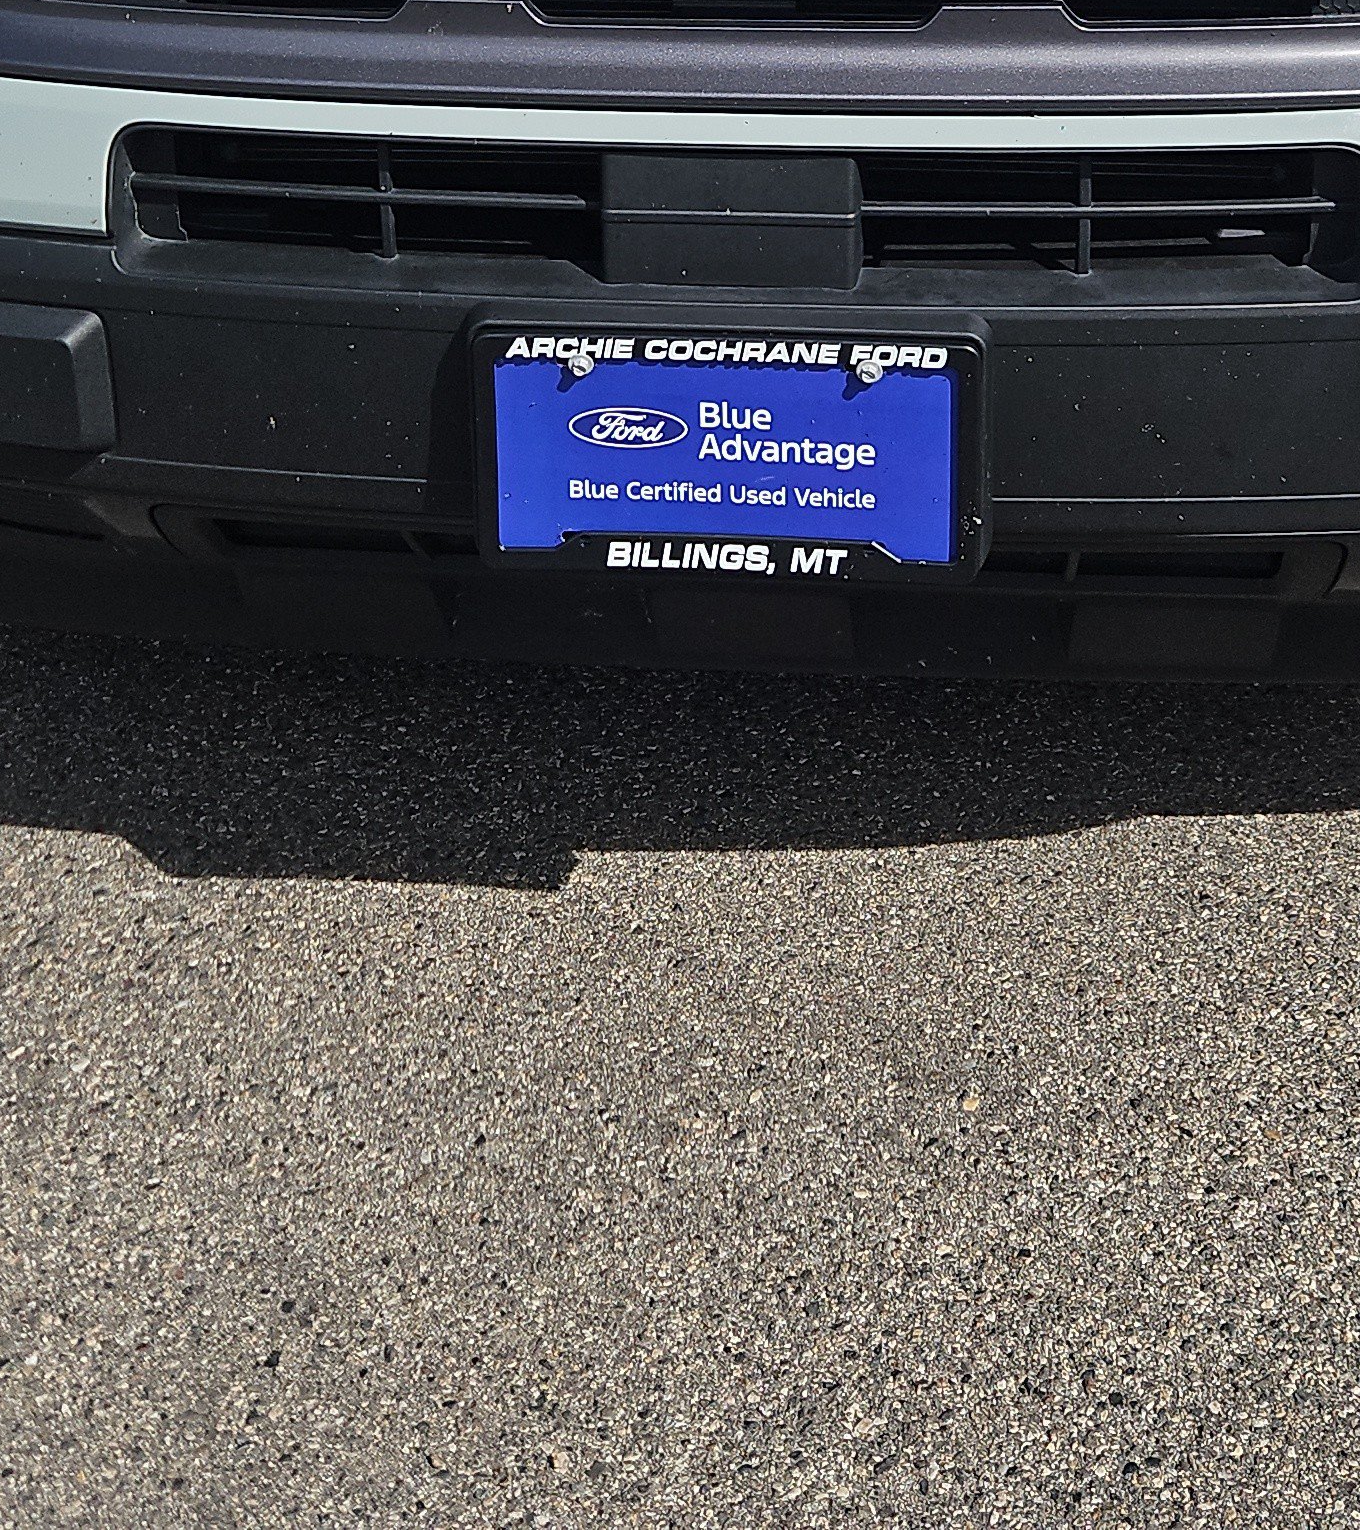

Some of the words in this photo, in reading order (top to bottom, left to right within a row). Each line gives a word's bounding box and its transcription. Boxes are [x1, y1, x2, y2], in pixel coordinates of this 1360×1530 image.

[505, 336, 634, 360] ARCHIE
[644, 339, 841, 365] COCHRANE
[849, 344, 948, 369] FORD
[591, 412, 664, 442] Ford
[698, 401, 772, 430] Blue
[698, 433, 876, 470] Advantage
[569, 479, 619, 499] Blue
[626, 481, 722, 503] Certified
[730, 484, 787, 506] Used
[794, 487, 876, 509] Vehicle
[606, 541, 776, 575] BILLINGS,
[790, 547, 848, 575] MT
